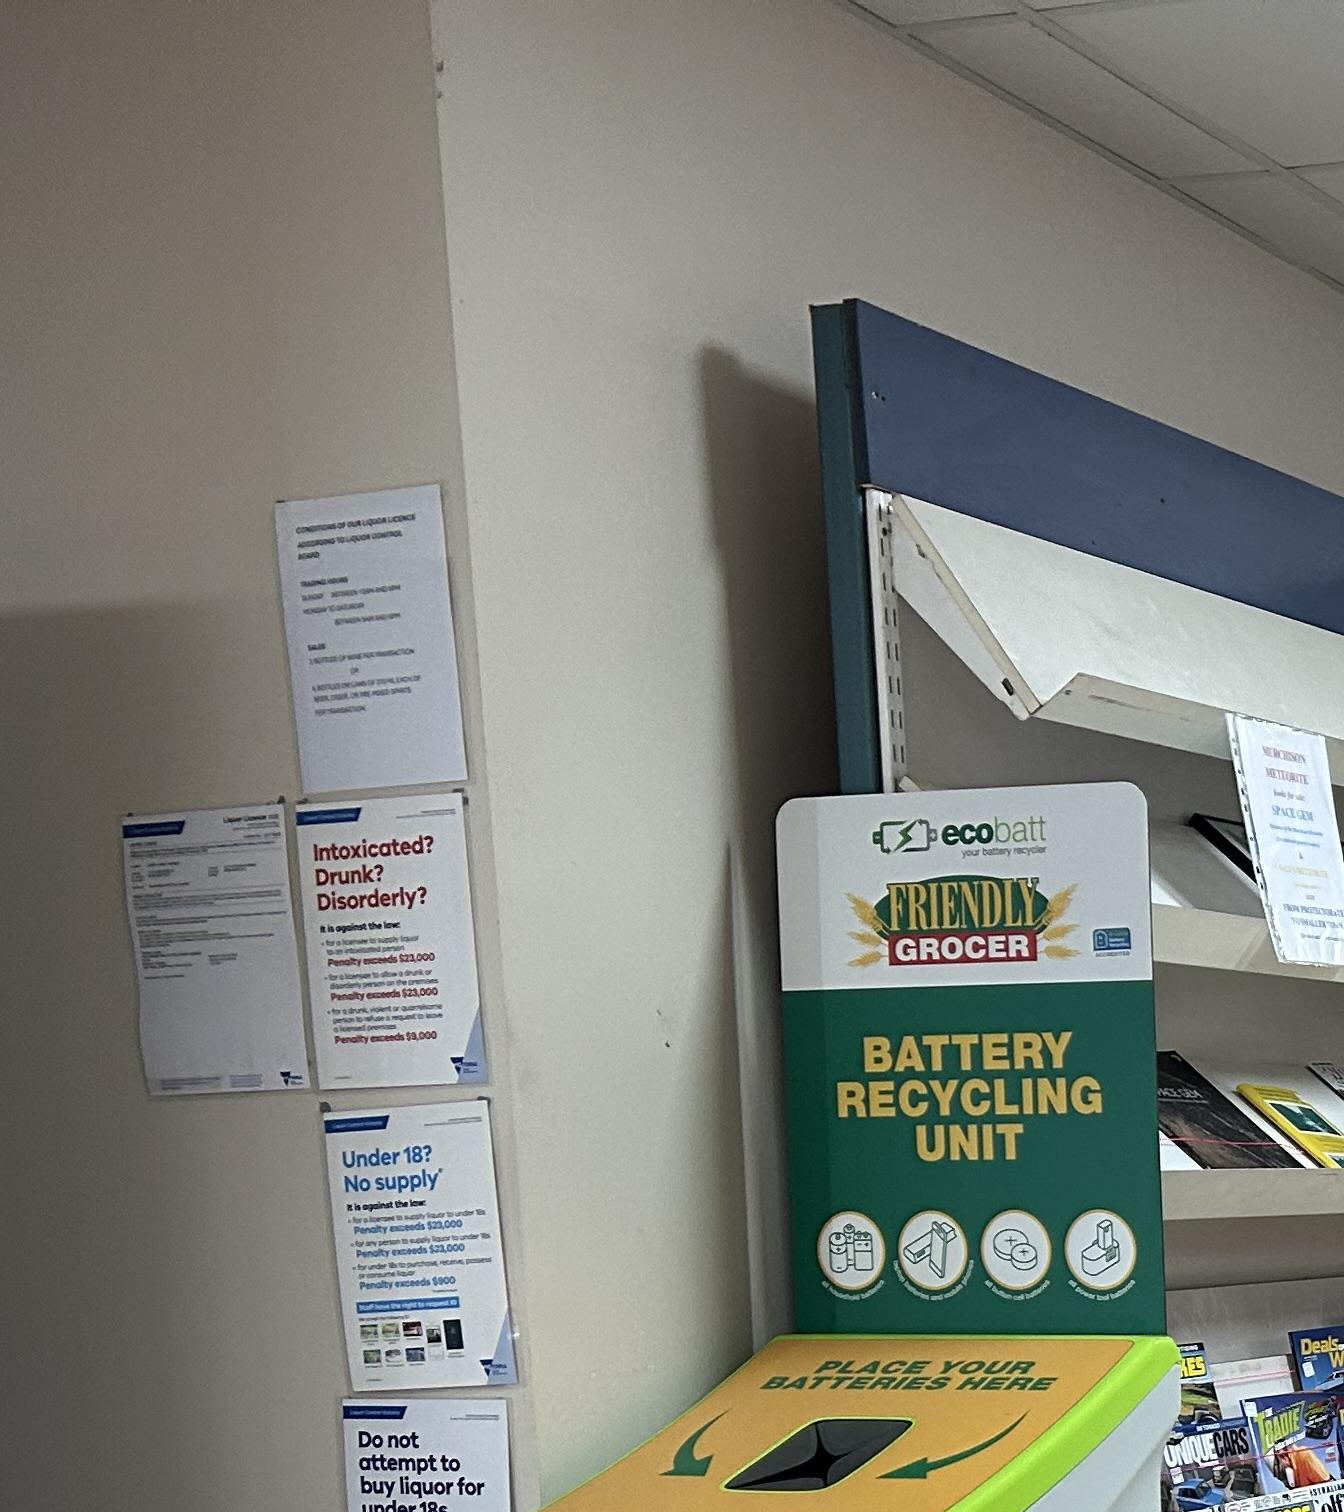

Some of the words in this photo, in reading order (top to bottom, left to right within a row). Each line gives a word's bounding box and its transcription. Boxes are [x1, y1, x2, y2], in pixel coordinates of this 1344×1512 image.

[362, 517, 387, 526] LIQUOR
[941, 816, 1046, 845] ecobatt
[313, 835, 434, 861] Intoxicated?
[961, 850, 979, 859] your
[982, 847, 1012, 857] battery
[1014, 846, 1046, 855] recycler
[316, 864, 384, 886] Drunk?
[317, 887, 427, 911] Disorderly?
[886, 877, 1040, 931] FRIENDLY
[328, 957, 361, 967] Penalty
[363, 955, 398, 965] exceeds
[400, 953, 435, 963] $23,000
[895, 935, 1030, 963] GROCER
[863, 1032, 1072, 1073] BATTERY
[836, 1076, 1103, 1118] RECYCLING
[916, 1123, 1024, 1161] UNIT
[342, 1149, 399, 1168] Under
[403, 1145, 432, 1164] 18?
[344, 1176, 370, 1192] No
[354, 1225, 387, 1234] Penalty
[390, 1222, 425, 1232] exceeds
[427, 1220, 463, 1230] $23,000
[360, 1281, 392, 1290] Penalty
[395, 1279, 430, 1288] exceeds
[432, 1276, 456, 1286] $900
[1301, 1336, 1339, 1355] Deals
[813, 1360, 930, 1374] PLACE
[940, 1360, 1036, 1374] YOUR
[760, 1376, 952, 1390] BATTERIES
[955, 1377, 1058, 1390] HERE
[358, 1431, 383, 1448] Do
[388, 1432, 419, 1448] not
[1164, 1434, 1215, 1468] UNIQUE
[1213, 1427, 1249, 1457] CARS
[359, 1455, 437, 1475] attempt
[441, 1456, 460, 1472] to
[360, 1476, 394, 1498] buy
[400, 1477, 453, 1499] liquor
[458, 1478, 484, 1496] for
